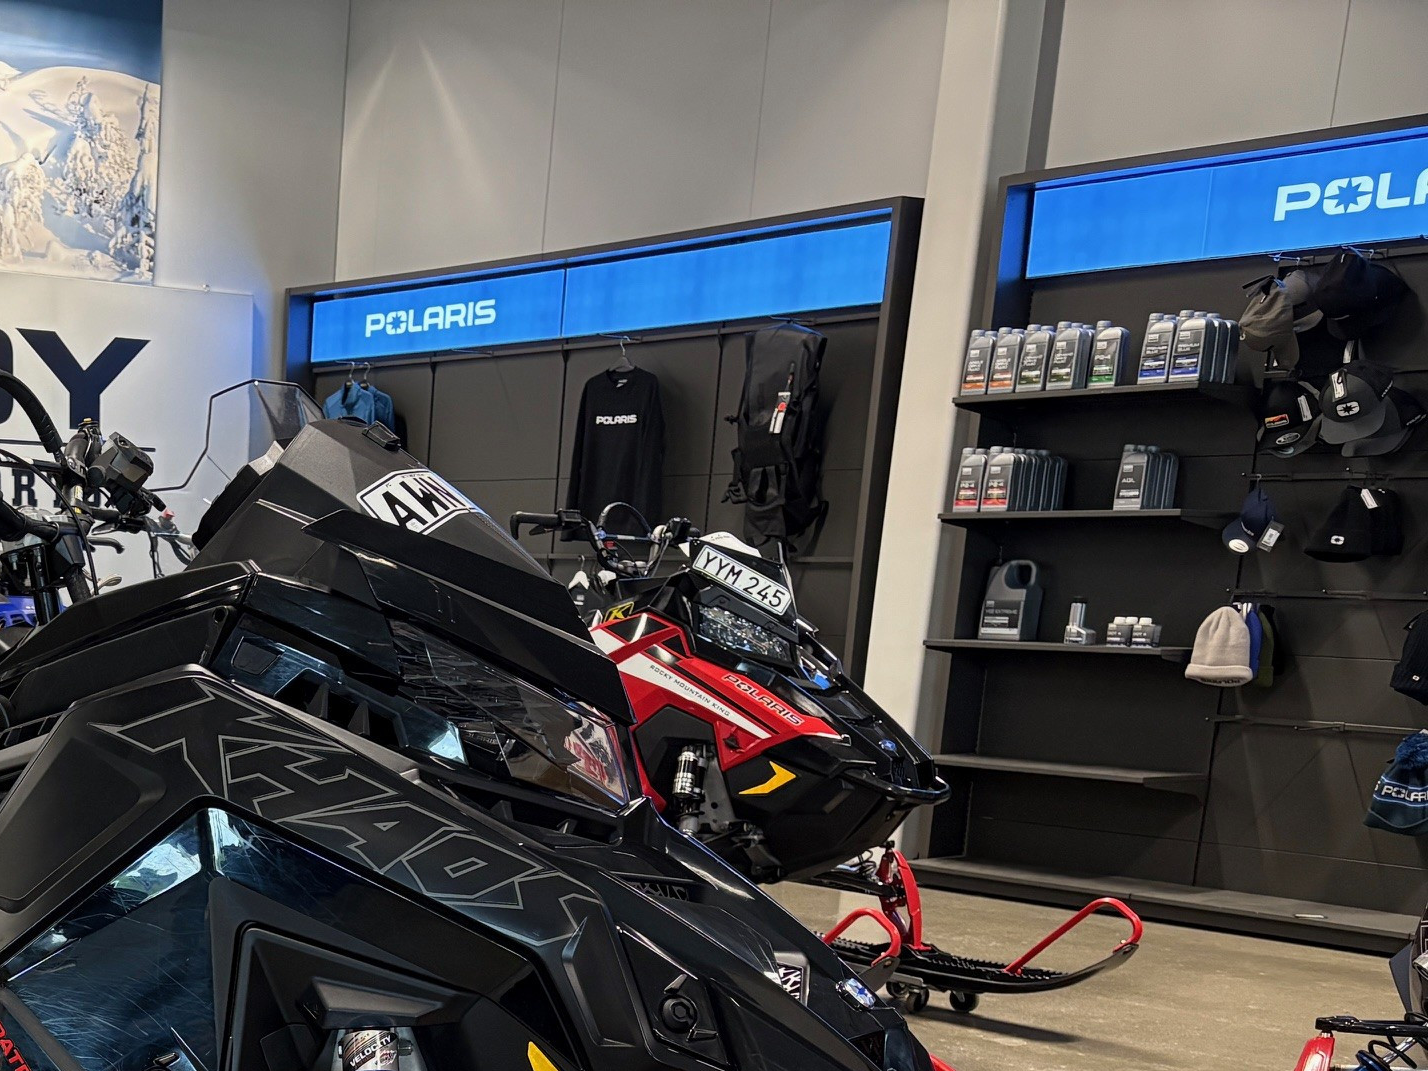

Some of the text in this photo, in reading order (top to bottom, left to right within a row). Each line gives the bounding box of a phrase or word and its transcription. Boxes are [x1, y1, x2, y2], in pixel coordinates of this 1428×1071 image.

[365, 298, 497, 338] POLARIS
[595, 414, 637, 425] POLARIS
[381, 476, 466, 527] AWN
[704, 551, 786, 608] YYM 245
[650, 664, 731, 717] ROCKY MOUNTAIN KING
[722, 674, 805, 726] POLARIS
[350, 1034, 391, 1067] VELOCTY
